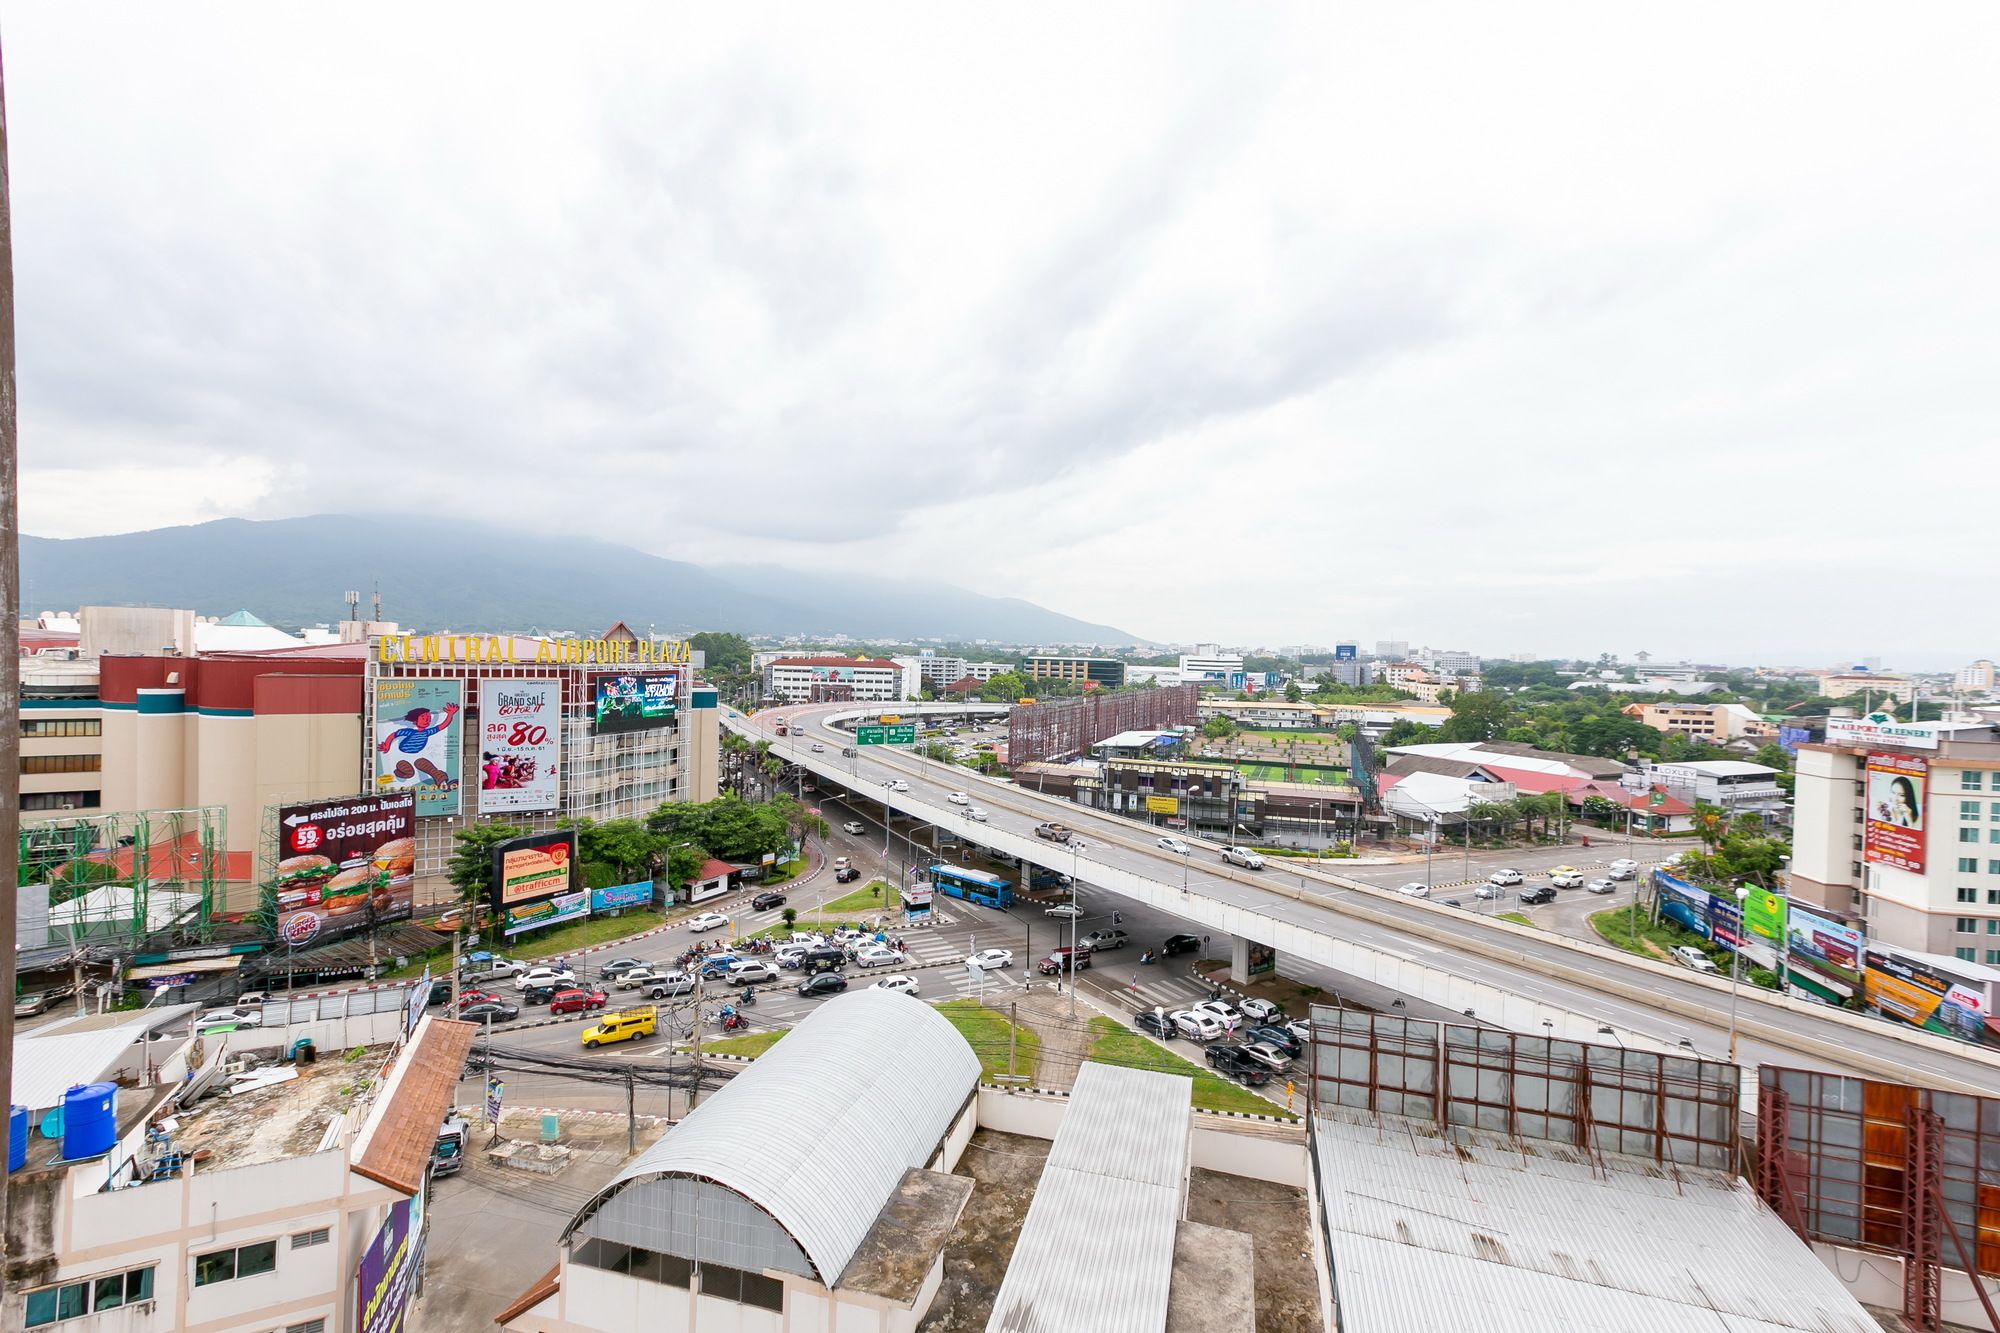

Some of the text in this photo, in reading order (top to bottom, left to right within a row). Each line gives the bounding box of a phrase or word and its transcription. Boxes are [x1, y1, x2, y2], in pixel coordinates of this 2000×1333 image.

[379, 634, 692, 664] CENTRAL AIRPORT PLAZA
[498, 691, 546, 706] GRAND SALE
[499, 703, 545, 715] GO FOR IT
[487, 723, 507, 733] ลด
[1840, 724, 1879, 734] AIRPORT
[1881, 726, 1932, 738] GREENERY
[486, 733, 507, 742] สูงสุด
[1659, 767, 1696, 777] LOXLEY
[310, 805, 349, 821] ตรงไปอีก
[351, 805, 368, 815] 200
[369, 803, 379, 812] ม.
[326, 814, 405, 840] อร่อยสุดคุ้ม
[514, 877, 561, 894] @trafficcm
[288, 915, 315, 933] BURGER
[291, 920, 316, 937] KING
